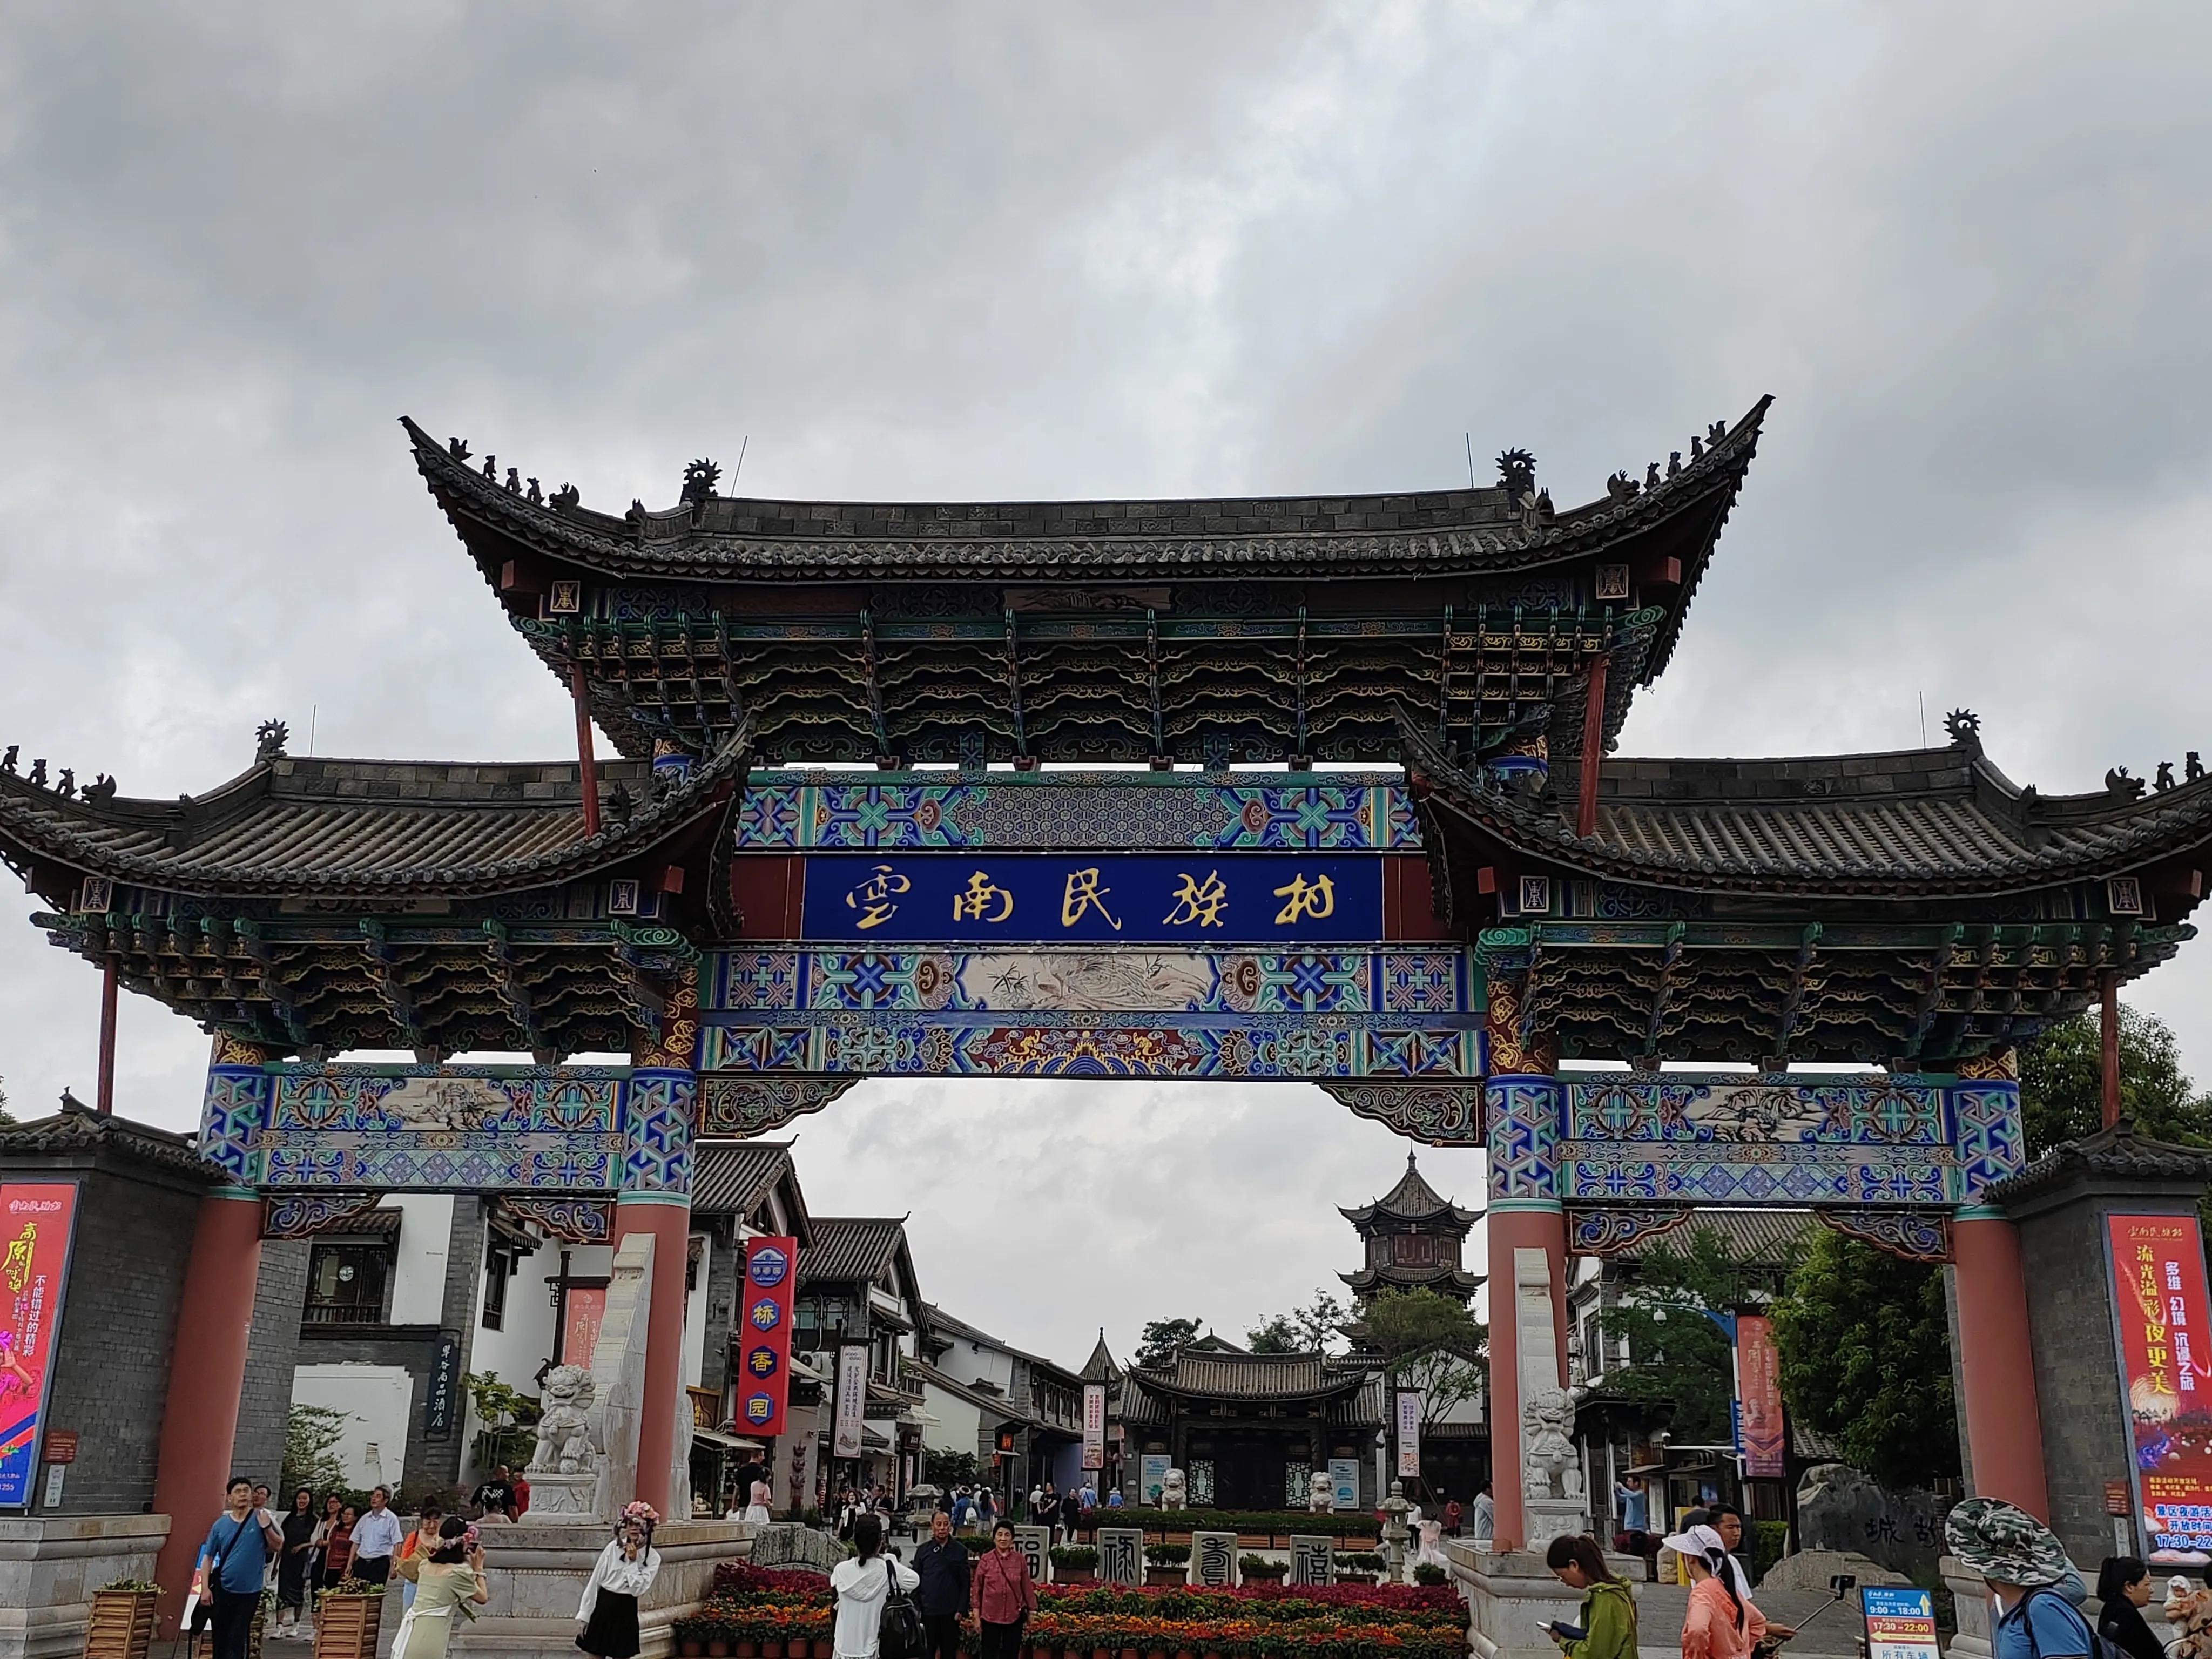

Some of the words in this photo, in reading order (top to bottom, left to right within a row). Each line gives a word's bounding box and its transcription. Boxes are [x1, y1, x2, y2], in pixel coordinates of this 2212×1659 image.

[2165, 1261, 2182, 1290] 多维
[22, 1275, 47, 1357] 不能错过的精彩
[2136, 1244, 2177, 1394] 流光溢彩夜更美
[2169, 1296, 2187, 1326] 幻境
[1869, 1606, 1889, 1614] 9:00
[1897, 1607, 1921, 1615] 18:00
[1873, 1622, 1896, 1630] 17:30
[1903, 1623, 1929, 1633] 22:00
